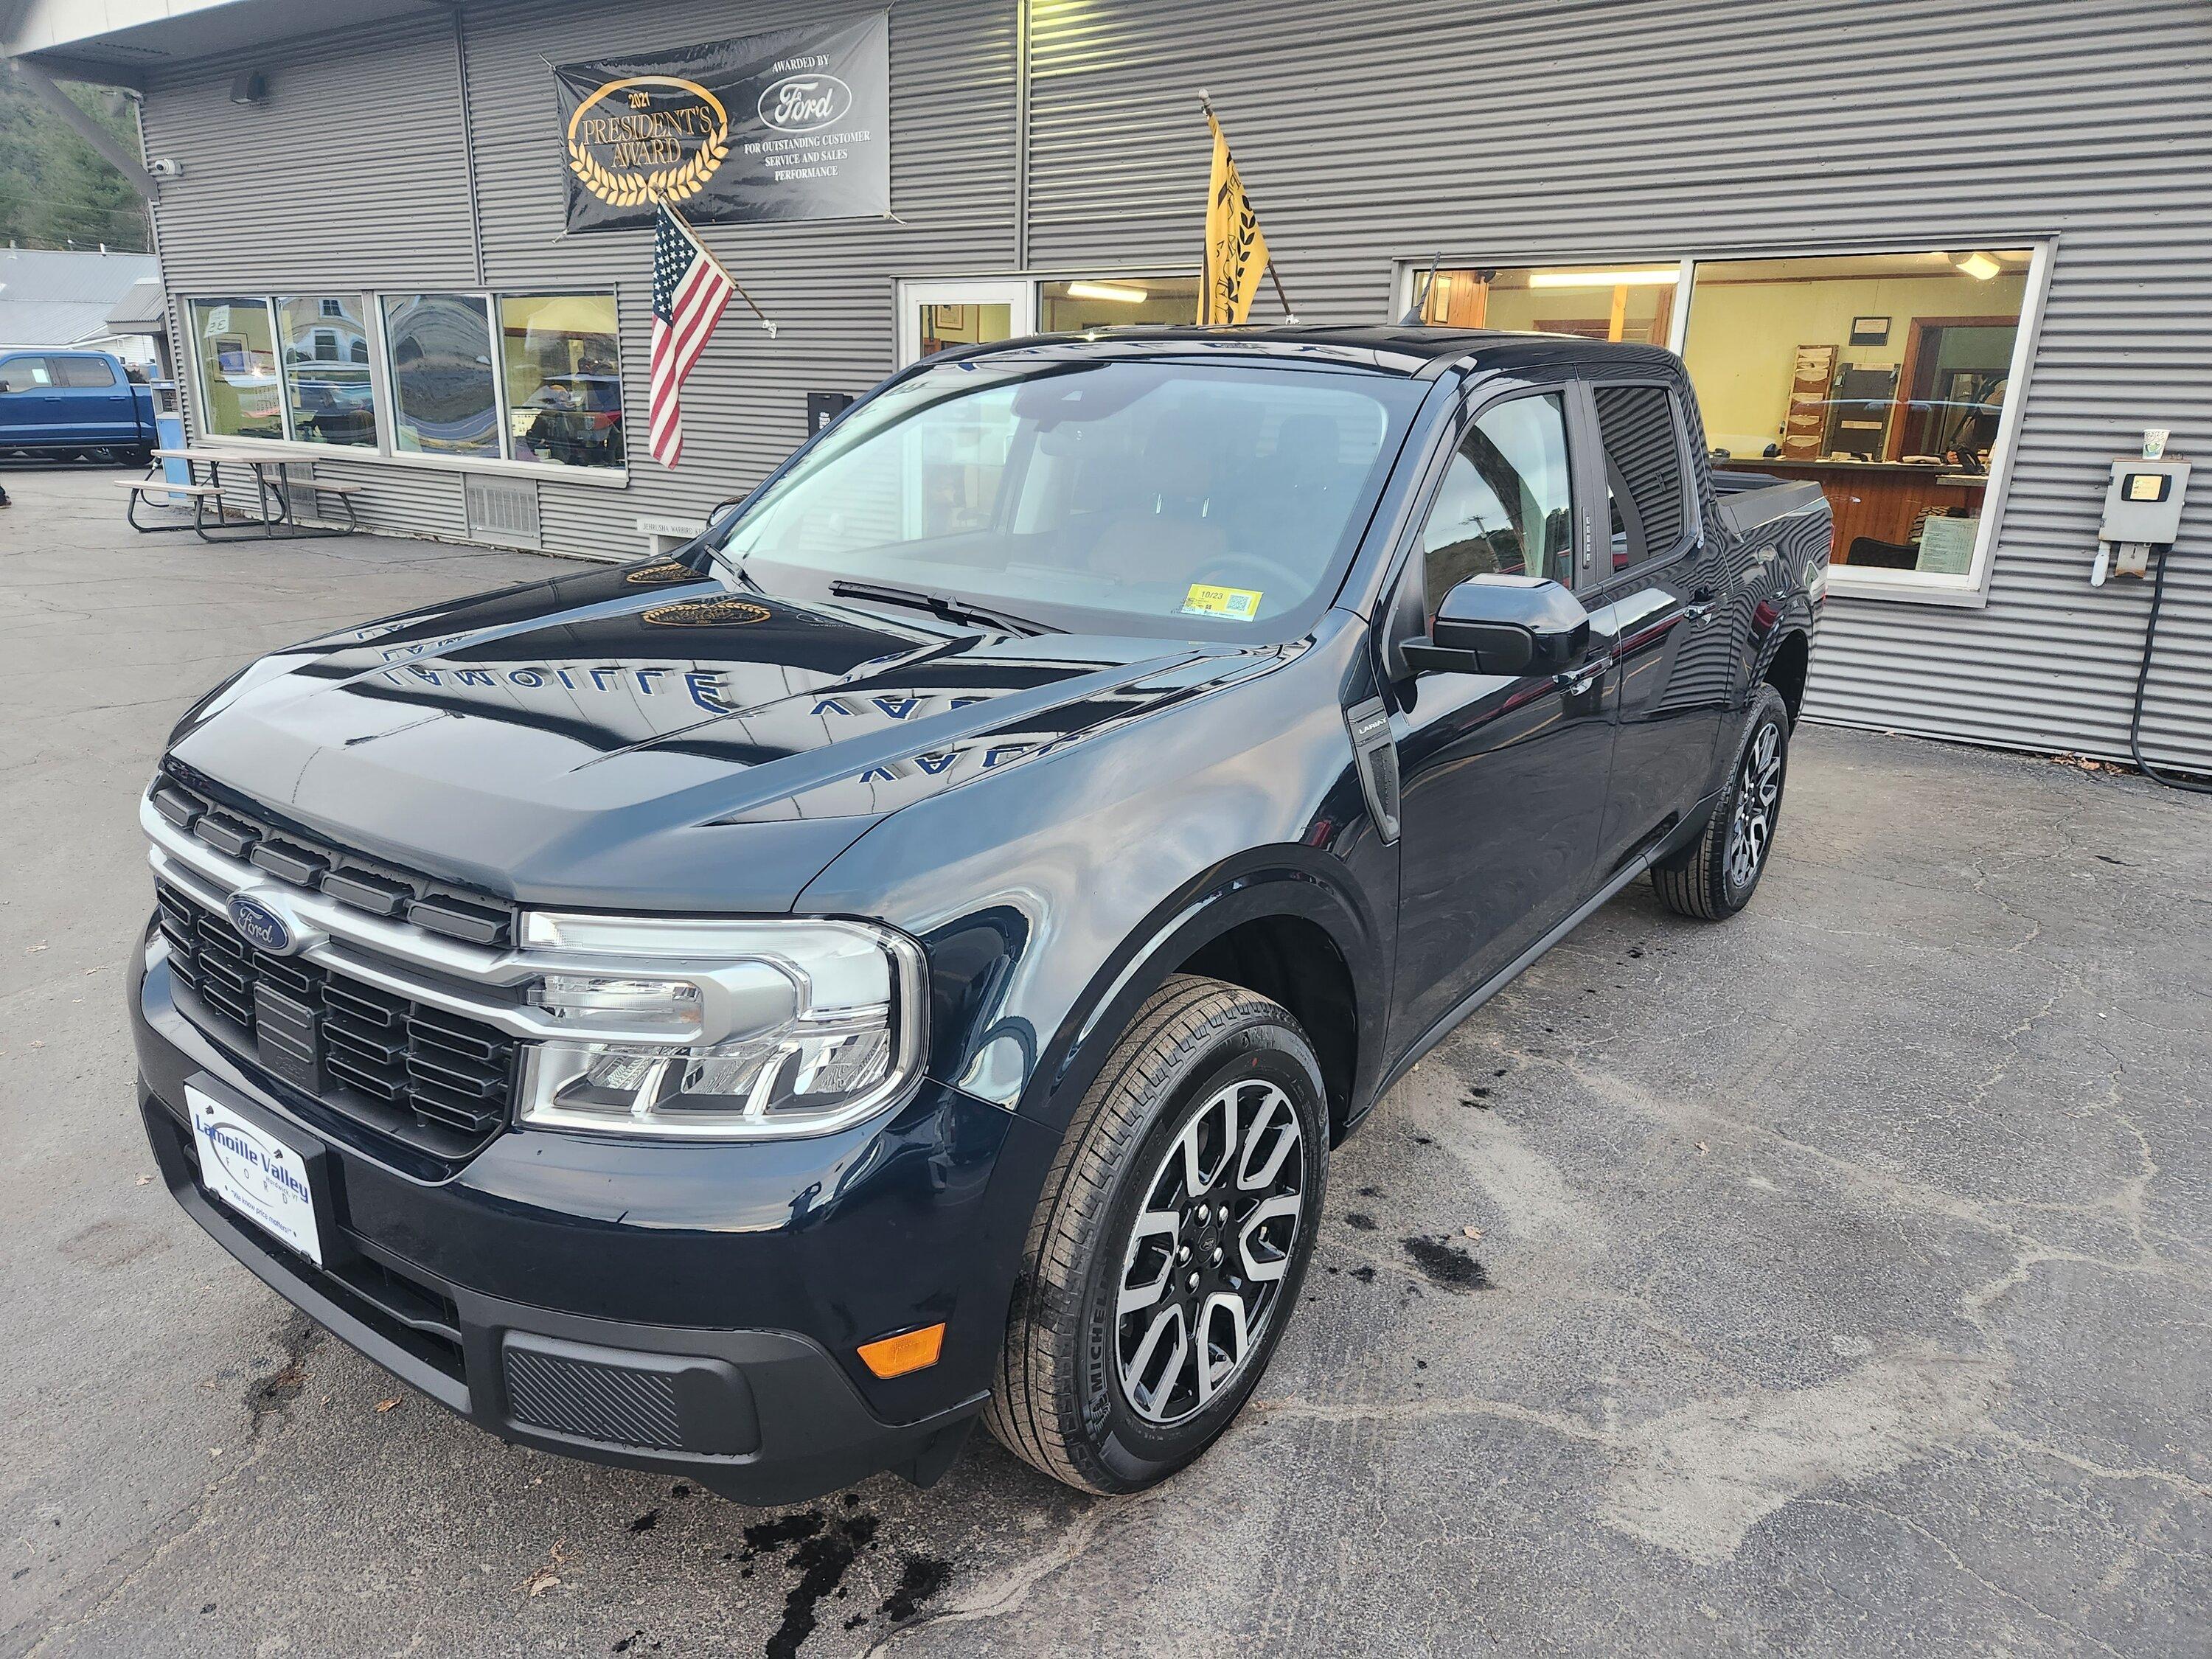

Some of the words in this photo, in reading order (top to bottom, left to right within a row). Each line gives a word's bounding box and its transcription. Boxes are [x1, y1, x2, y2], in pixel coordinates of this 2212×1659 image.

[772, 56, 815, 72] AWARDED
[817, 55, 830, 67] BY
[628, 91, 651, 108] 2021
[774, 82, 833, 124] Ford
[582, 105, 713, 145] PRESIDENT'S
[611, 137, 681, 168] AWARD
[744, 143, 762, 155] FOR
[762, 136, 821, 153] OUTSTANDING
[822, 131, 871, 146] CUSTOMER
[765, 153, 800, 167] SERVICE
[801, 151, 820, 164] AND
[821, 149, 848, 161] SALES
[775, 166, 839, 182] PERFORMANCE
[1201, 591, 1223, 600] 10/23
[1359, 717, 1388, 734] LARIAT
[237, 905, 273, 943] Ford
[195, 1113, 259, 1166] Lamoille
[261, 1152, 309, 1204] Valley
